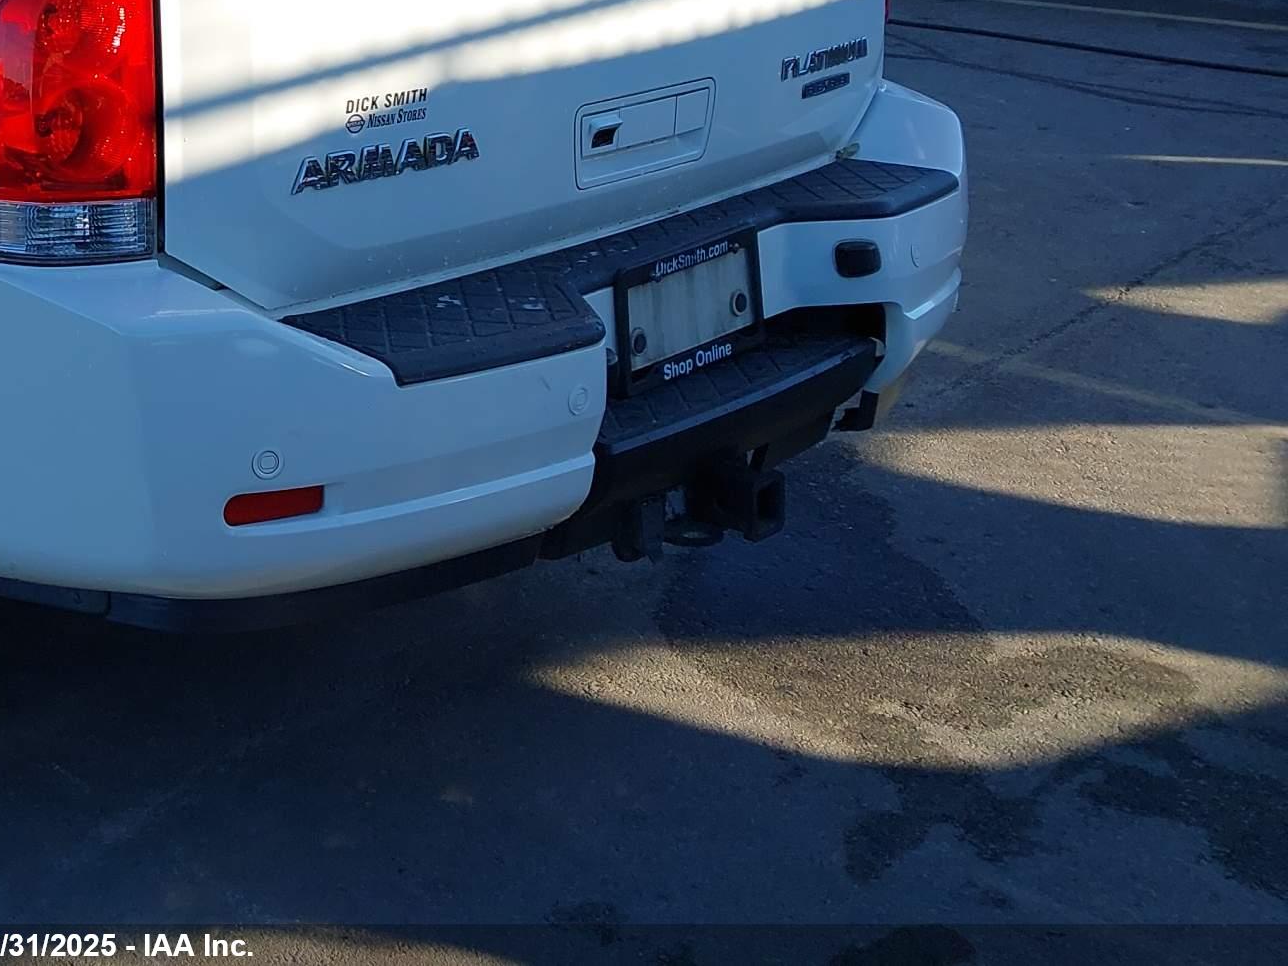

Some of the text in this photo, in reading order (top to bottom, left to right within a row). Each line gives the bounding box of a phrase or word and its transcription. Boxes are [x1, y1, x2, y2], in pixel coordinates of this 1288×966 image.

[345, 88, 427, 114] DICK SMITH
[367, 110, 397, 129] NISSAN
[397, 107, 427, 124] STORES
[290, 128, 480, 195] ARMADA
[663, 343, 732, 381] Shop Online
